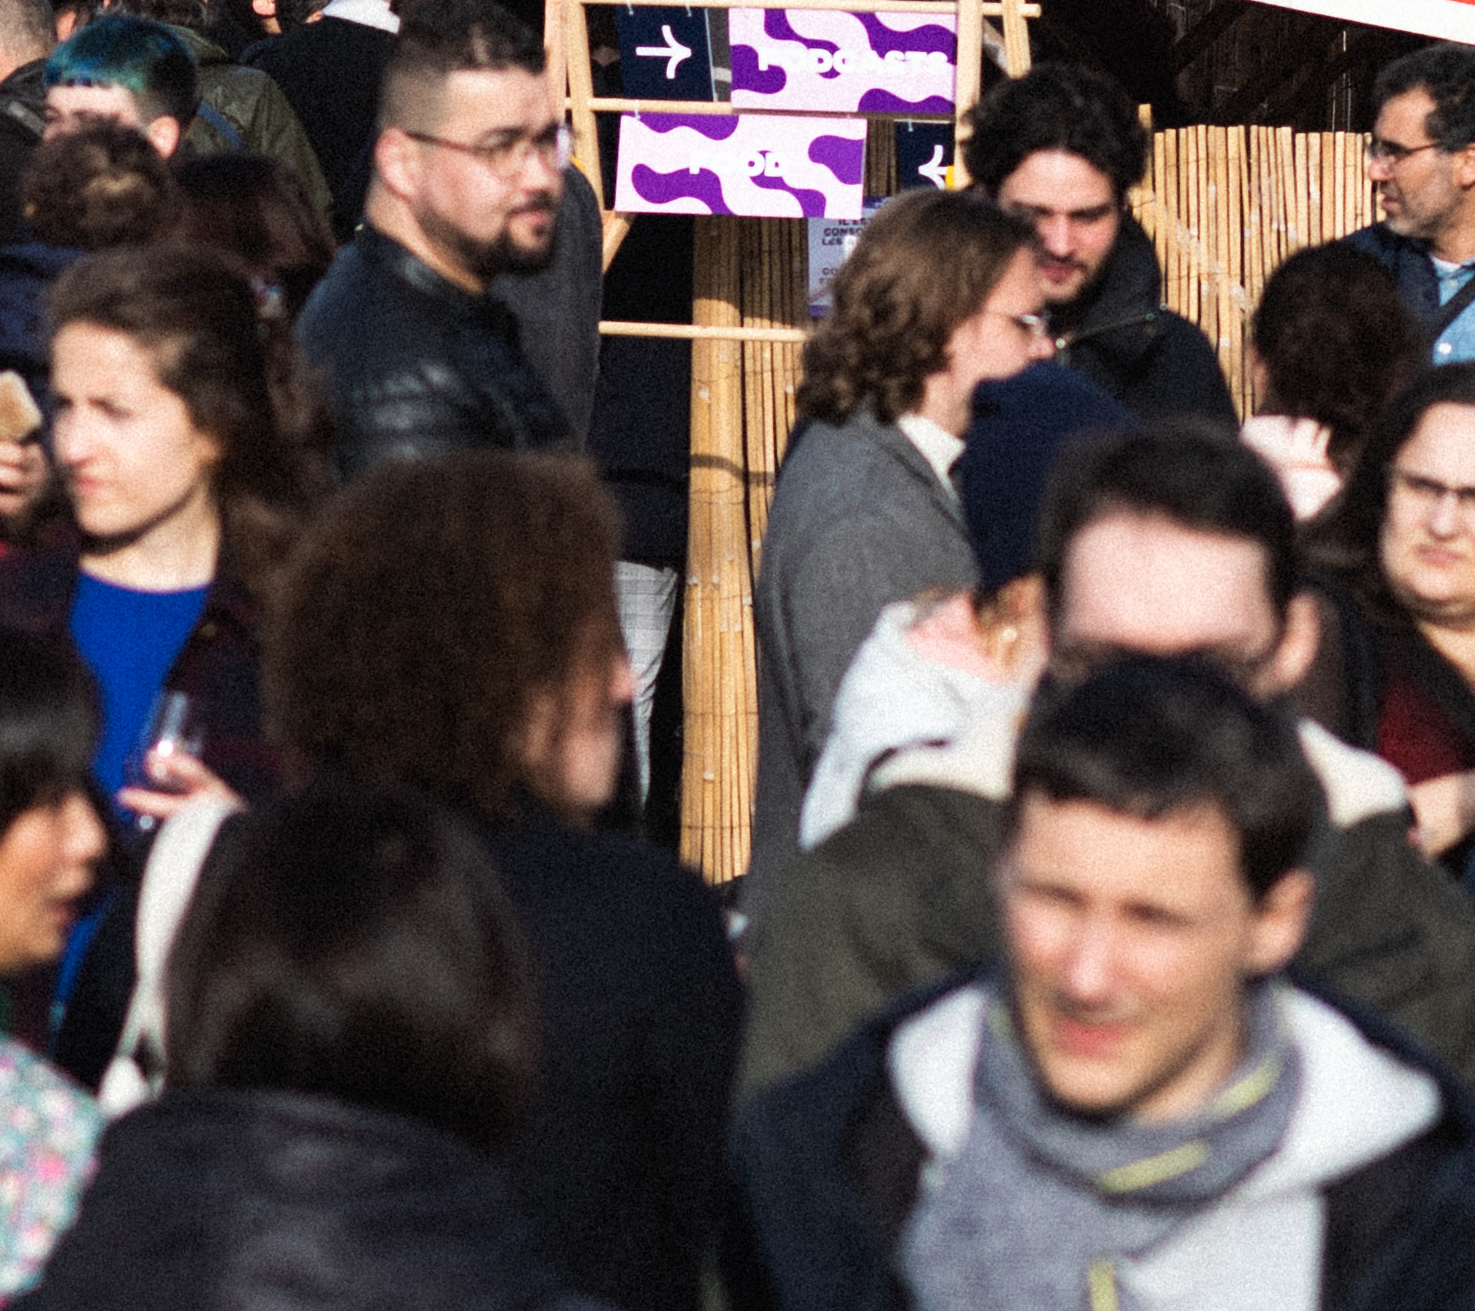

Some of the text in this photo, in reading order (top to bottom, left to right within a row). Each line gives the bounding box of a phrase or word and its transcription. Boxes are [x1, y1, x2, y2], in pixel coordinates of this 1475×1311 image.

[757, 47, 949, 75] PODCASTS
[689, 150, 789, 177] FOOD
[823, 227, 864, 237] CONSO
